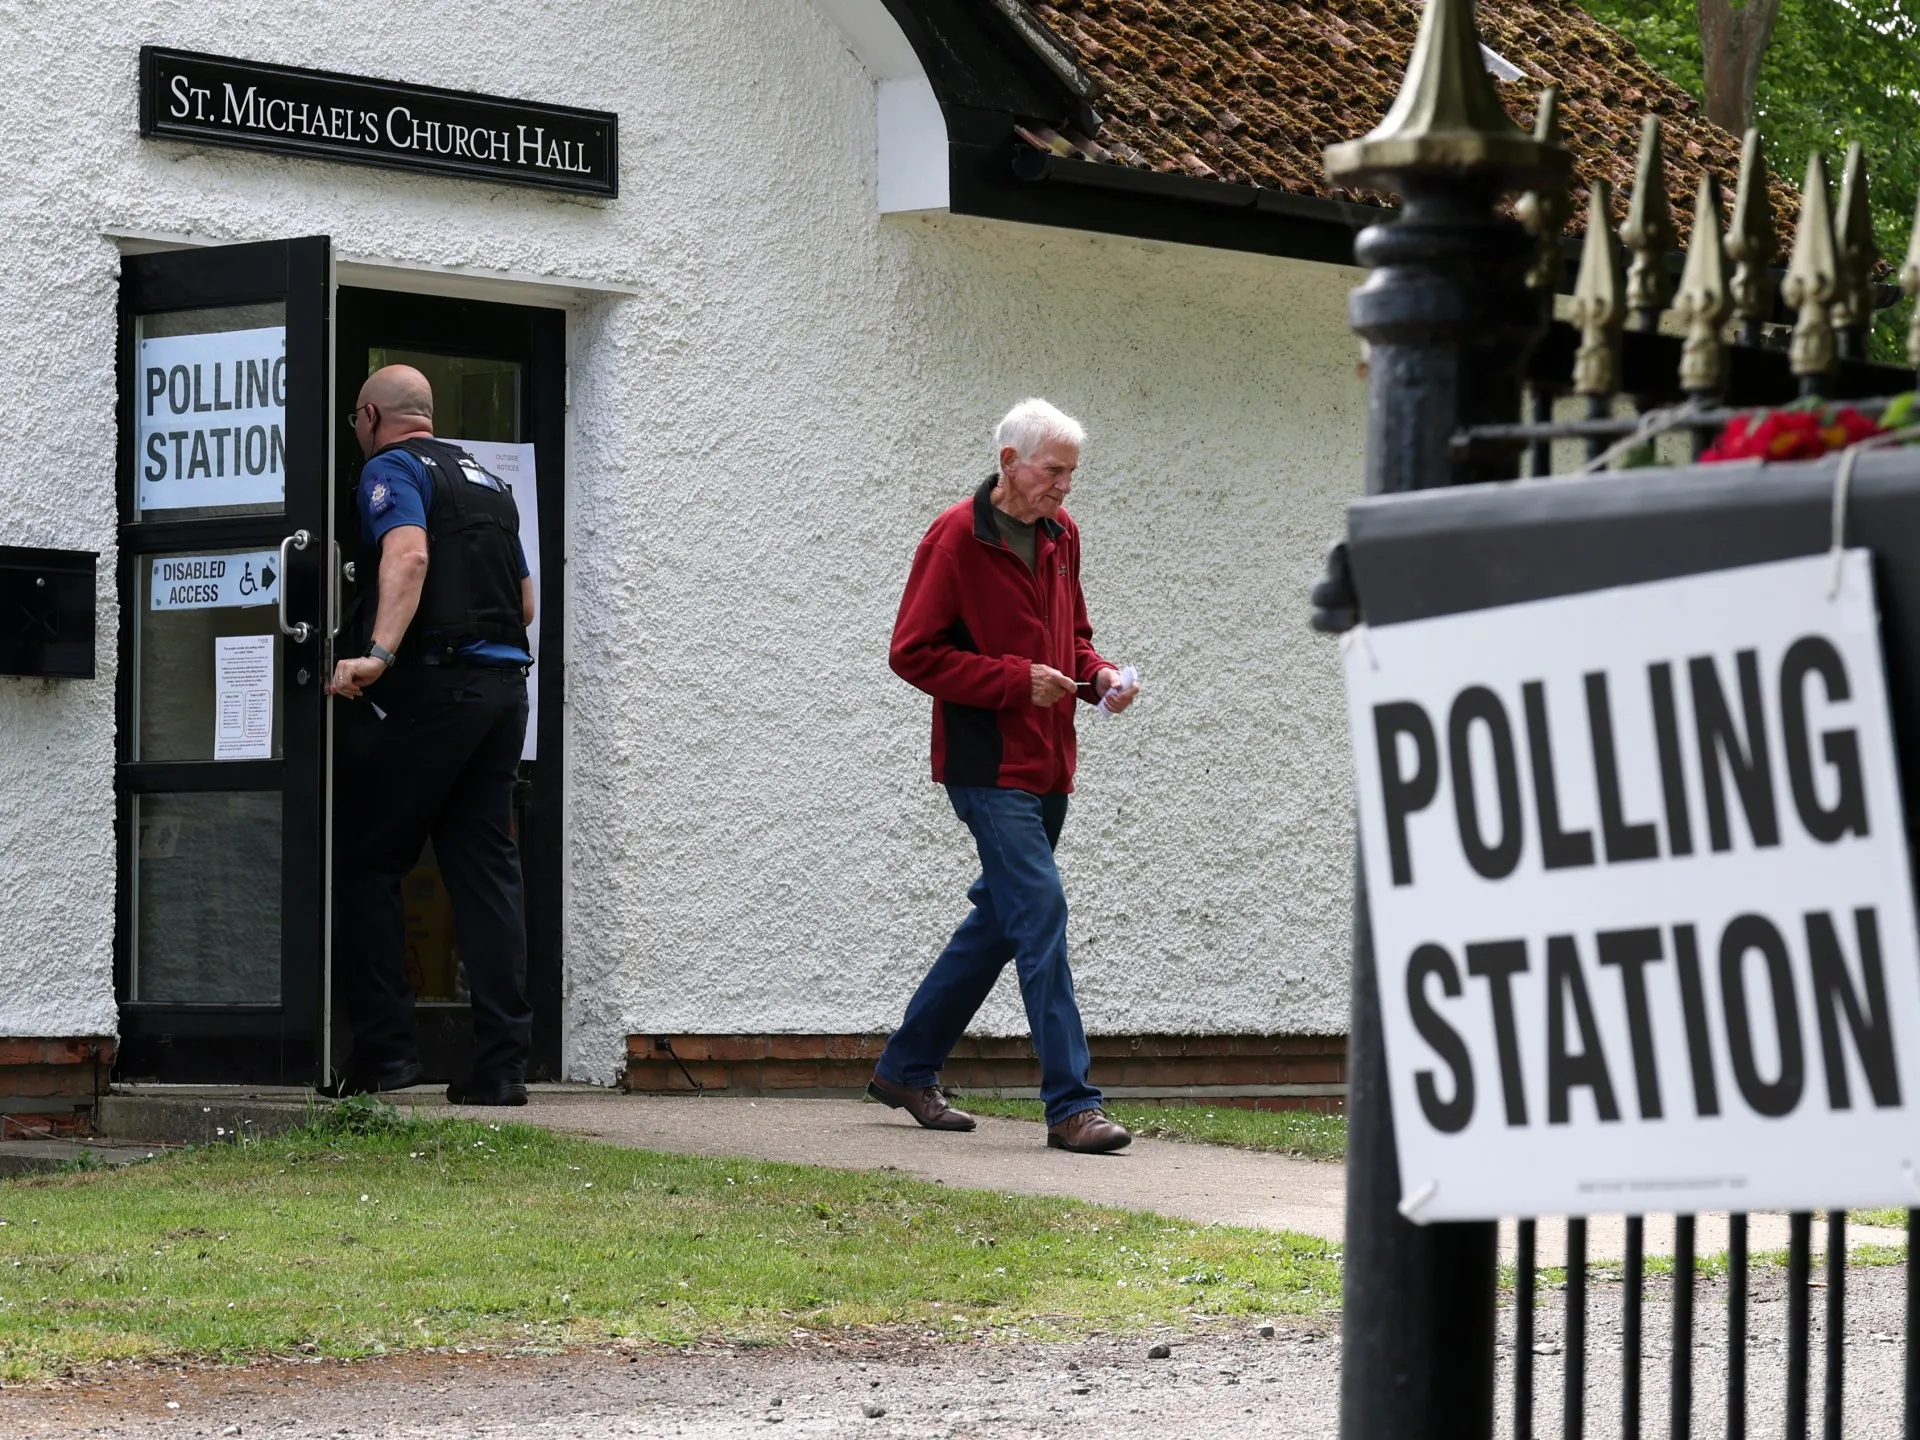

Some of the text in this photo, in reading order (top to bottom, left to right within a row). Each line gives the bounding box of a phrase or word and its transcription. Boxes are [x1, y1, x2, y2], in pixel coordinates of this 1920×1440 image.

[170, 75, 216, 123] ST.
[385, 106, 511, 162] CHURCH
[516, 124, 591, 173] HALL
[146, 355, 286, 417] POLLING
[144, 424, 286, 482] STATION
[495, 454, 519, 462] OUTSIDE
[496, 464, 520, 472] NOTICES
[163, 561, 226, 581] DISABLED
[169, 584, 219, 604] ACCESS
[1372, 634, 1870, 888] POLLING
[1405, 906, 1904, 1134] STATION
